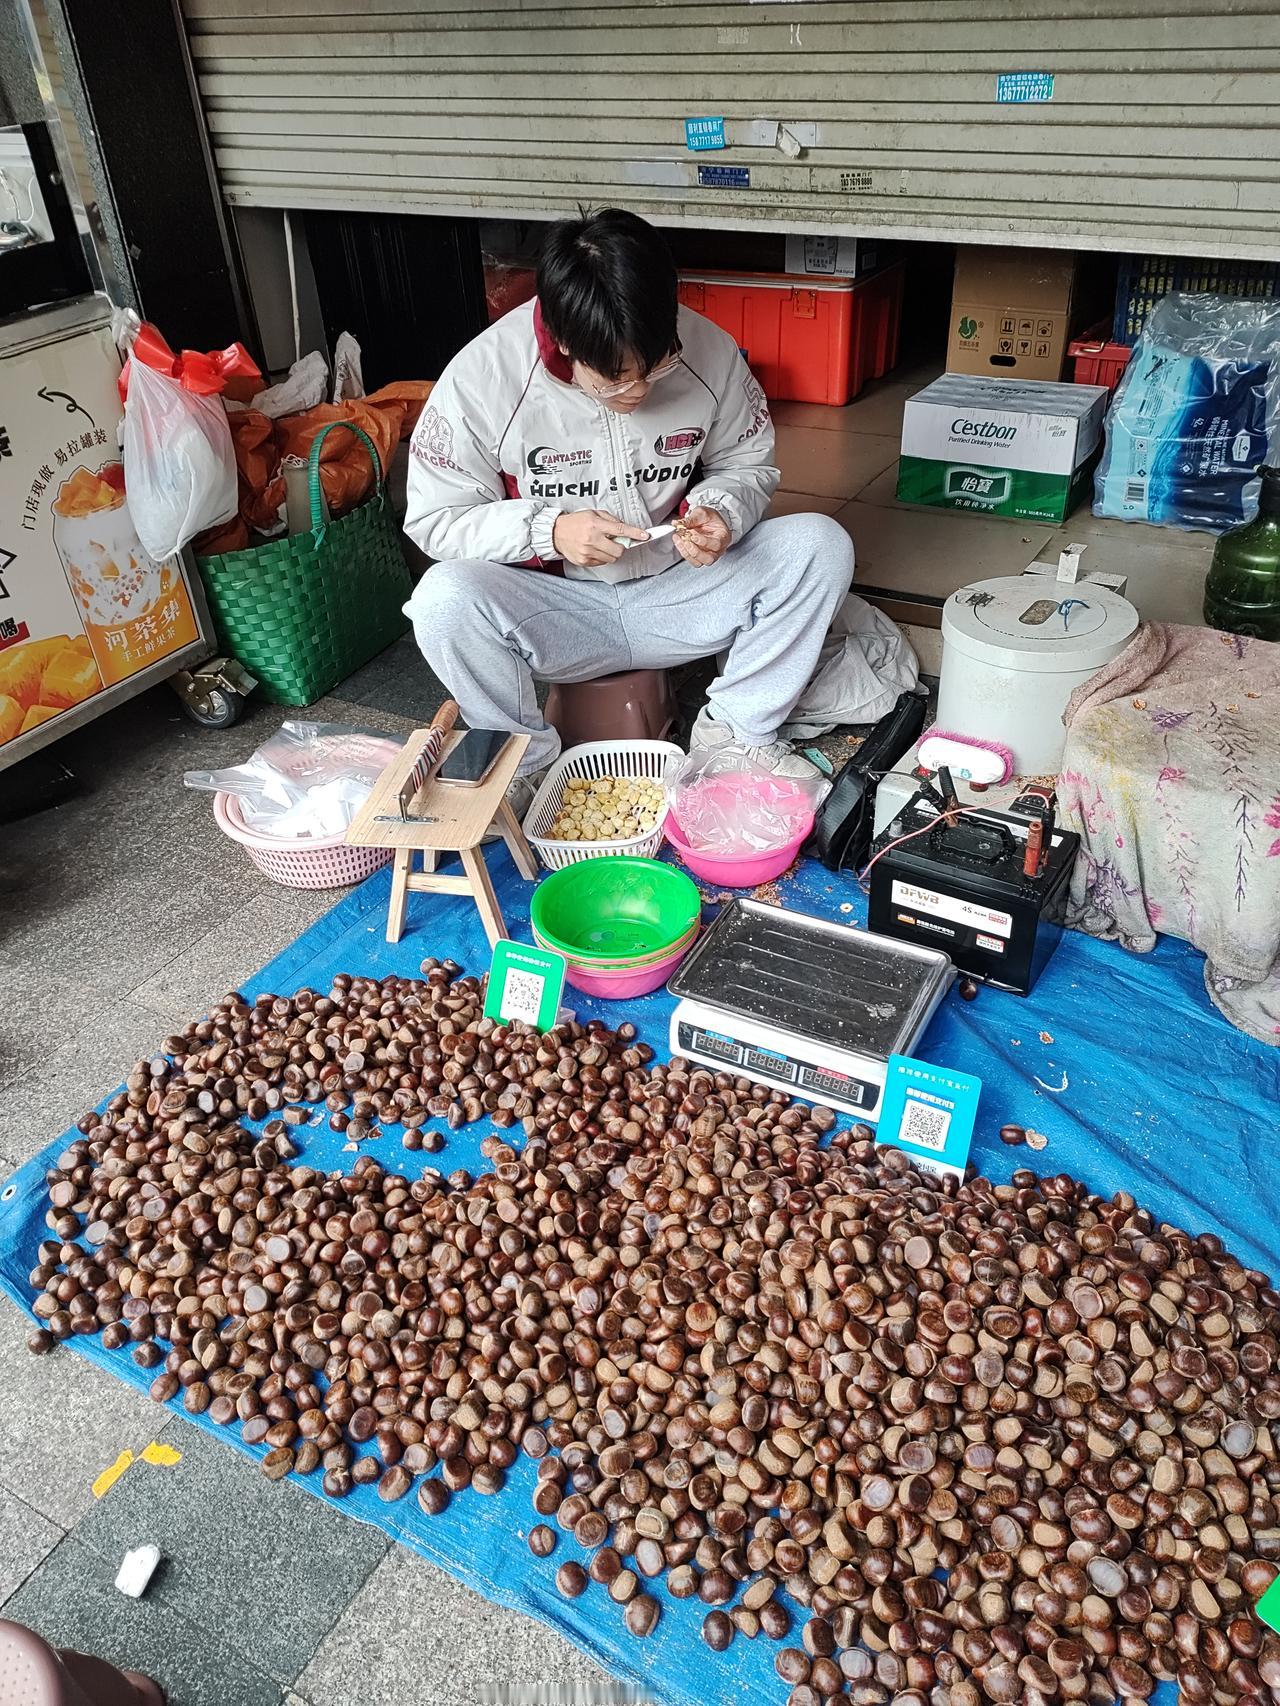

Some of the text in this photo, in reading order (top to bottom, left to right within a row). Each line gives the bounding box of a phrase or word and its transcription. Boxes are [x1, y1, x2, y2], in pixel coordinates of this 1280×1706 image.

[999, 85, 1048, 101] 13677712272
[541, 449, 593, 464] FANTASTIC
[21, 428, 107, 531] 门店现做 易拉罐装
